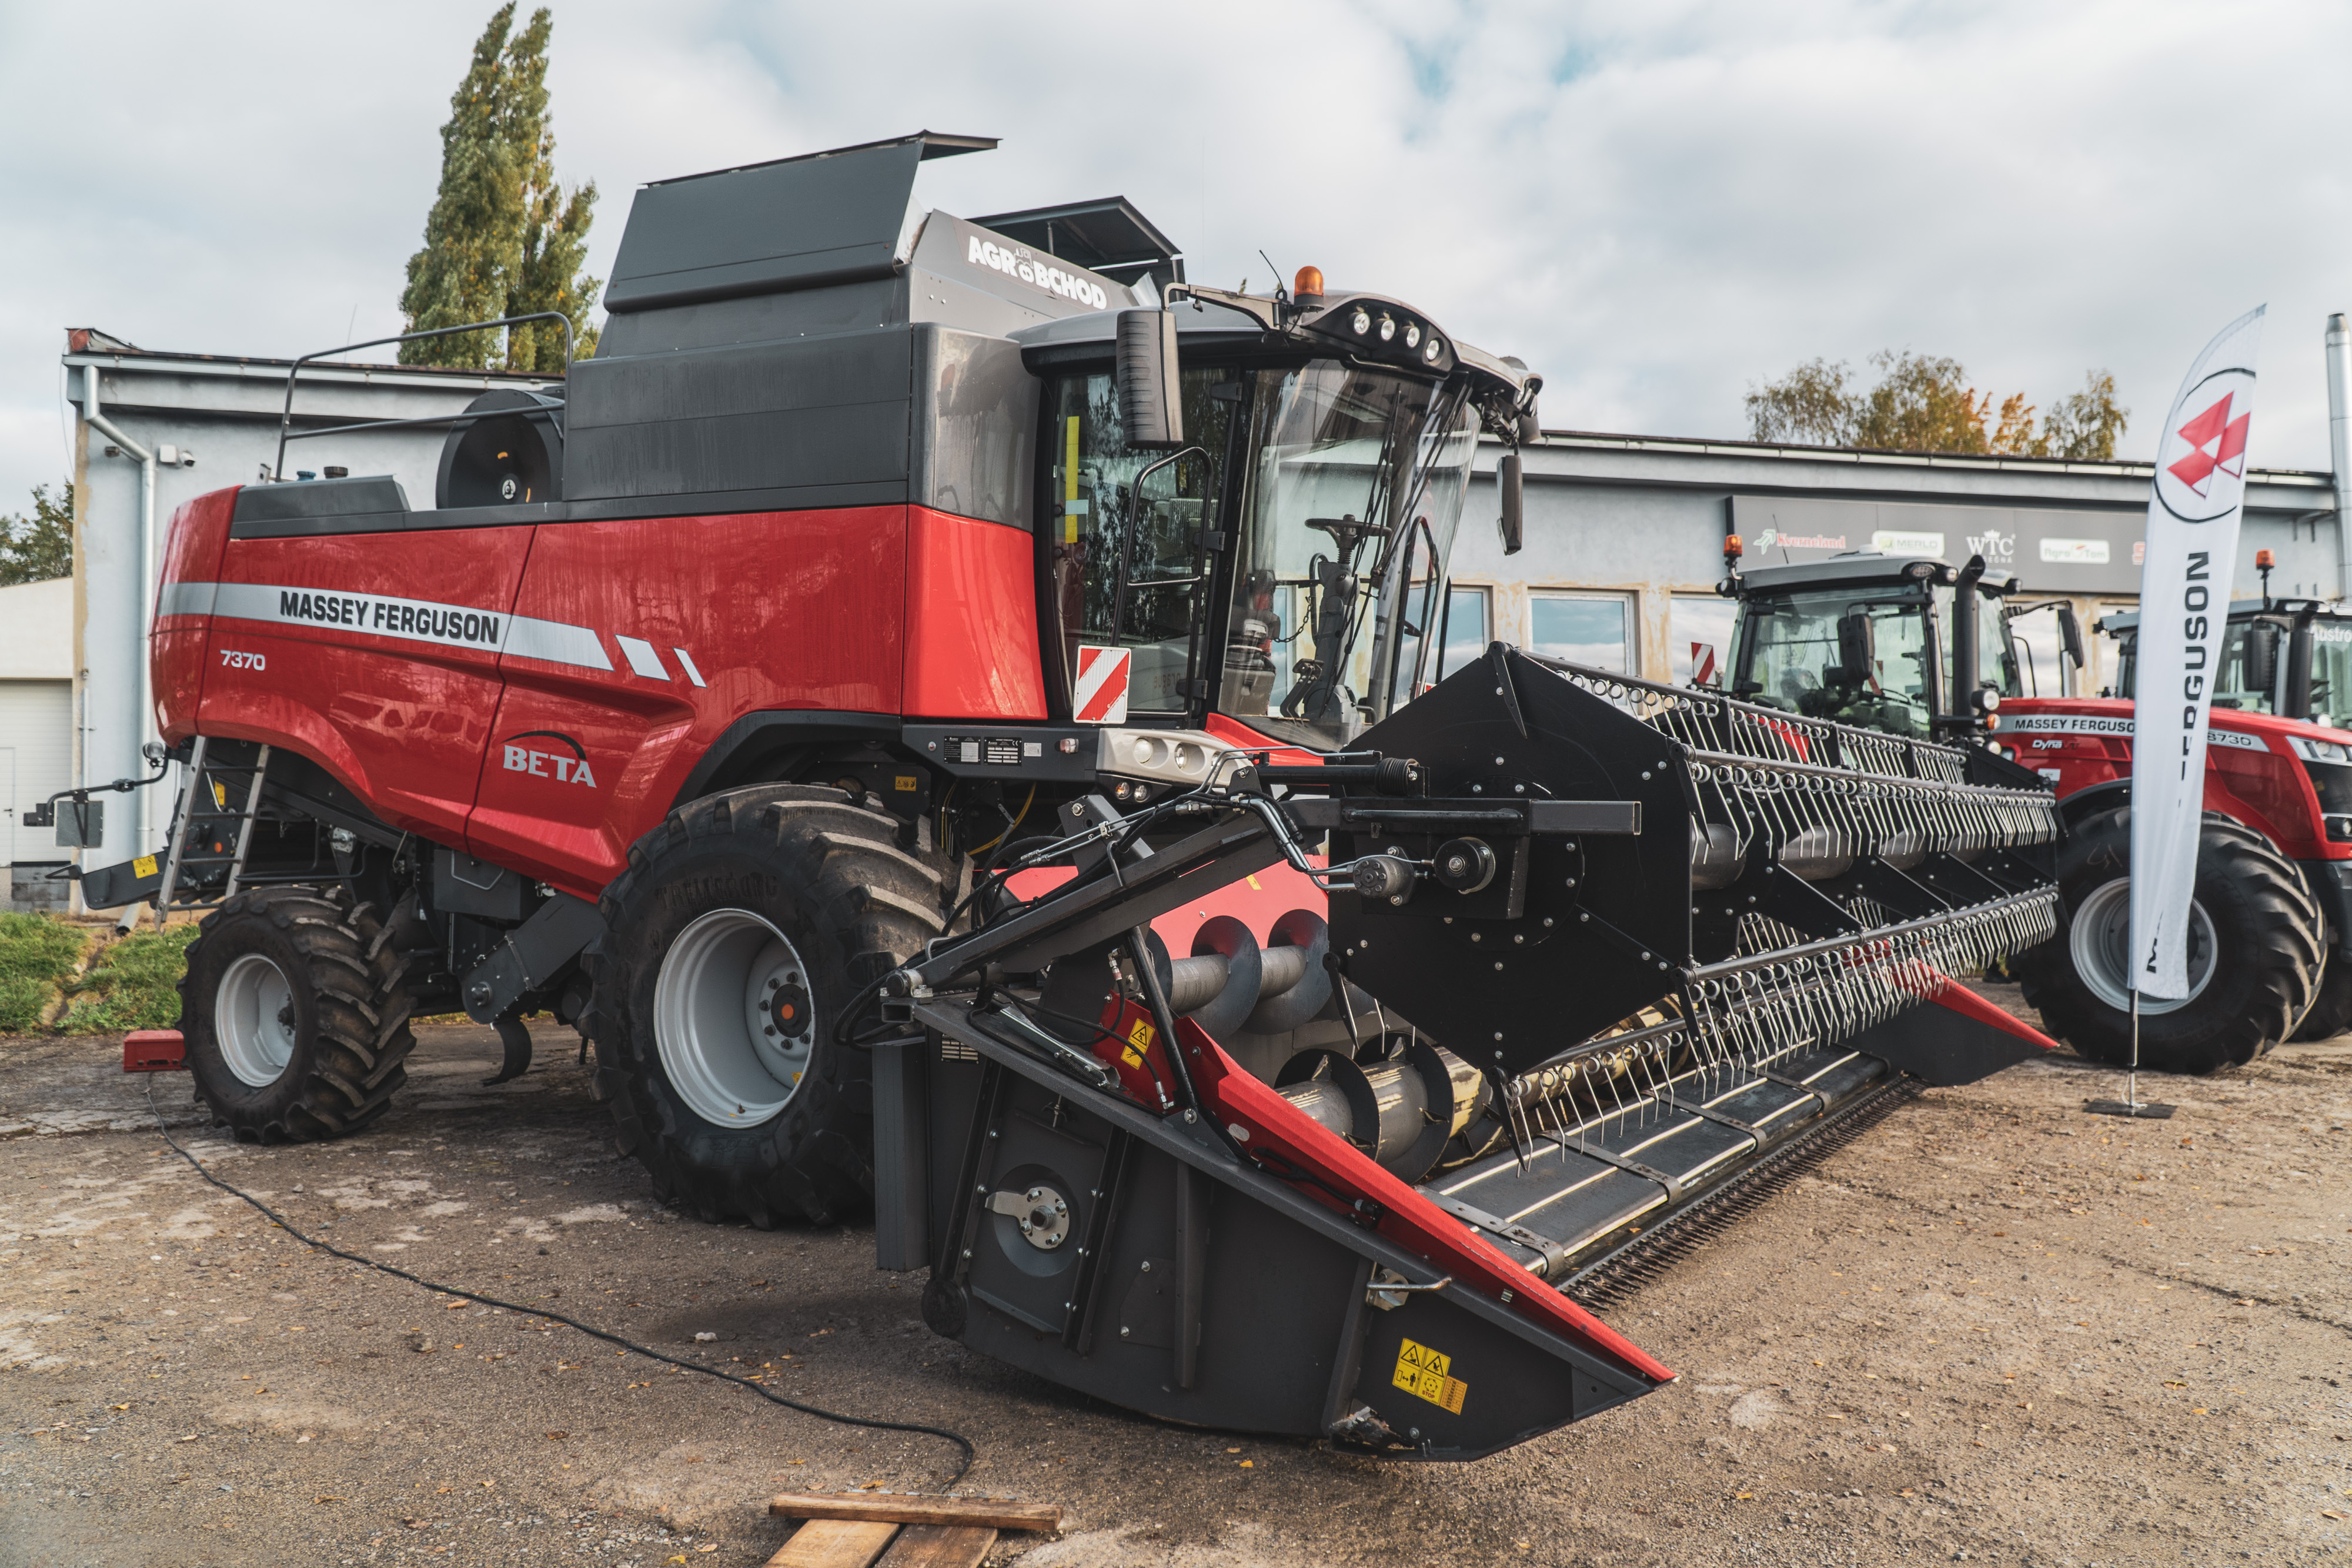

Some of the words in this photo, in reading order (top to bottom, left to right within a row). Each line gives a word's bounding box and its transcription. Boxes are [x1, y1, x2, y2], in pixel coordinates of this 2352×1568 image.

[968, 236, 1107, 310] AGROBCHOD
[1777, 532, 1846, 550] Kverneland
[1897, 539, 1938, 550] MERLO
[1966, 536, 2014, 556] WTC
[280, 591, 369, 626] MASSEY
[373, 603, 499, 644] FERGUSON
[220, 650, 266, 671] 7370
[2015, 719, 2067, 730] MASSEY
[2072, 720, 2135, 733] FERGUSO
[2207, 732, 2251, 746] 8730
[503, 745, 597, 788] BETA
[1422, 1390, 1435, 1399] STOP
